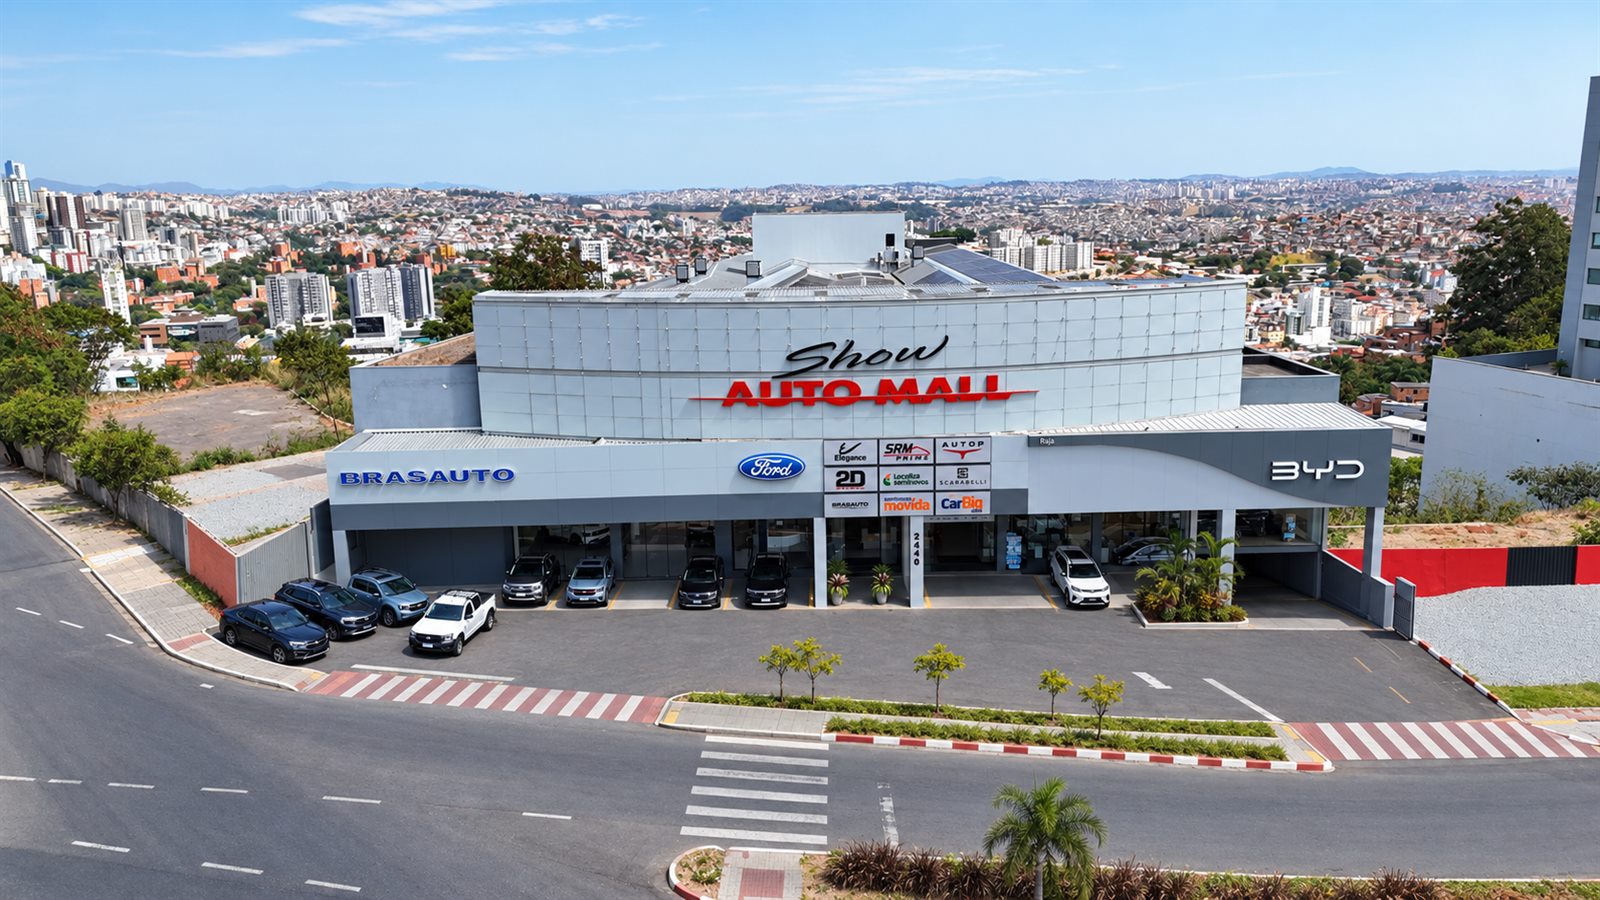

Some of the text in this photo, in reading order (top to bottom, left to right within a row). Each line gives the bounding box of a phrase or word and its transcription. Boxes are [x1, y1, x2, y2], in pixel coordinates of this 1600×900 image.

[772, 335, 949, 379] Show
[722, 375, 1012, 407] AUTO MALL
[884, 443, 914, 454] SRM
[1040, 437, 1055, 445] Raja
[834, 454, 867, 462] Elegance
[751, 458, 793, 476] Ford
[1271, 460, 1365, 480] BYD
[340, 468, 515, 485] BRASAUTO
[836, 470, 866, 487] 2D
